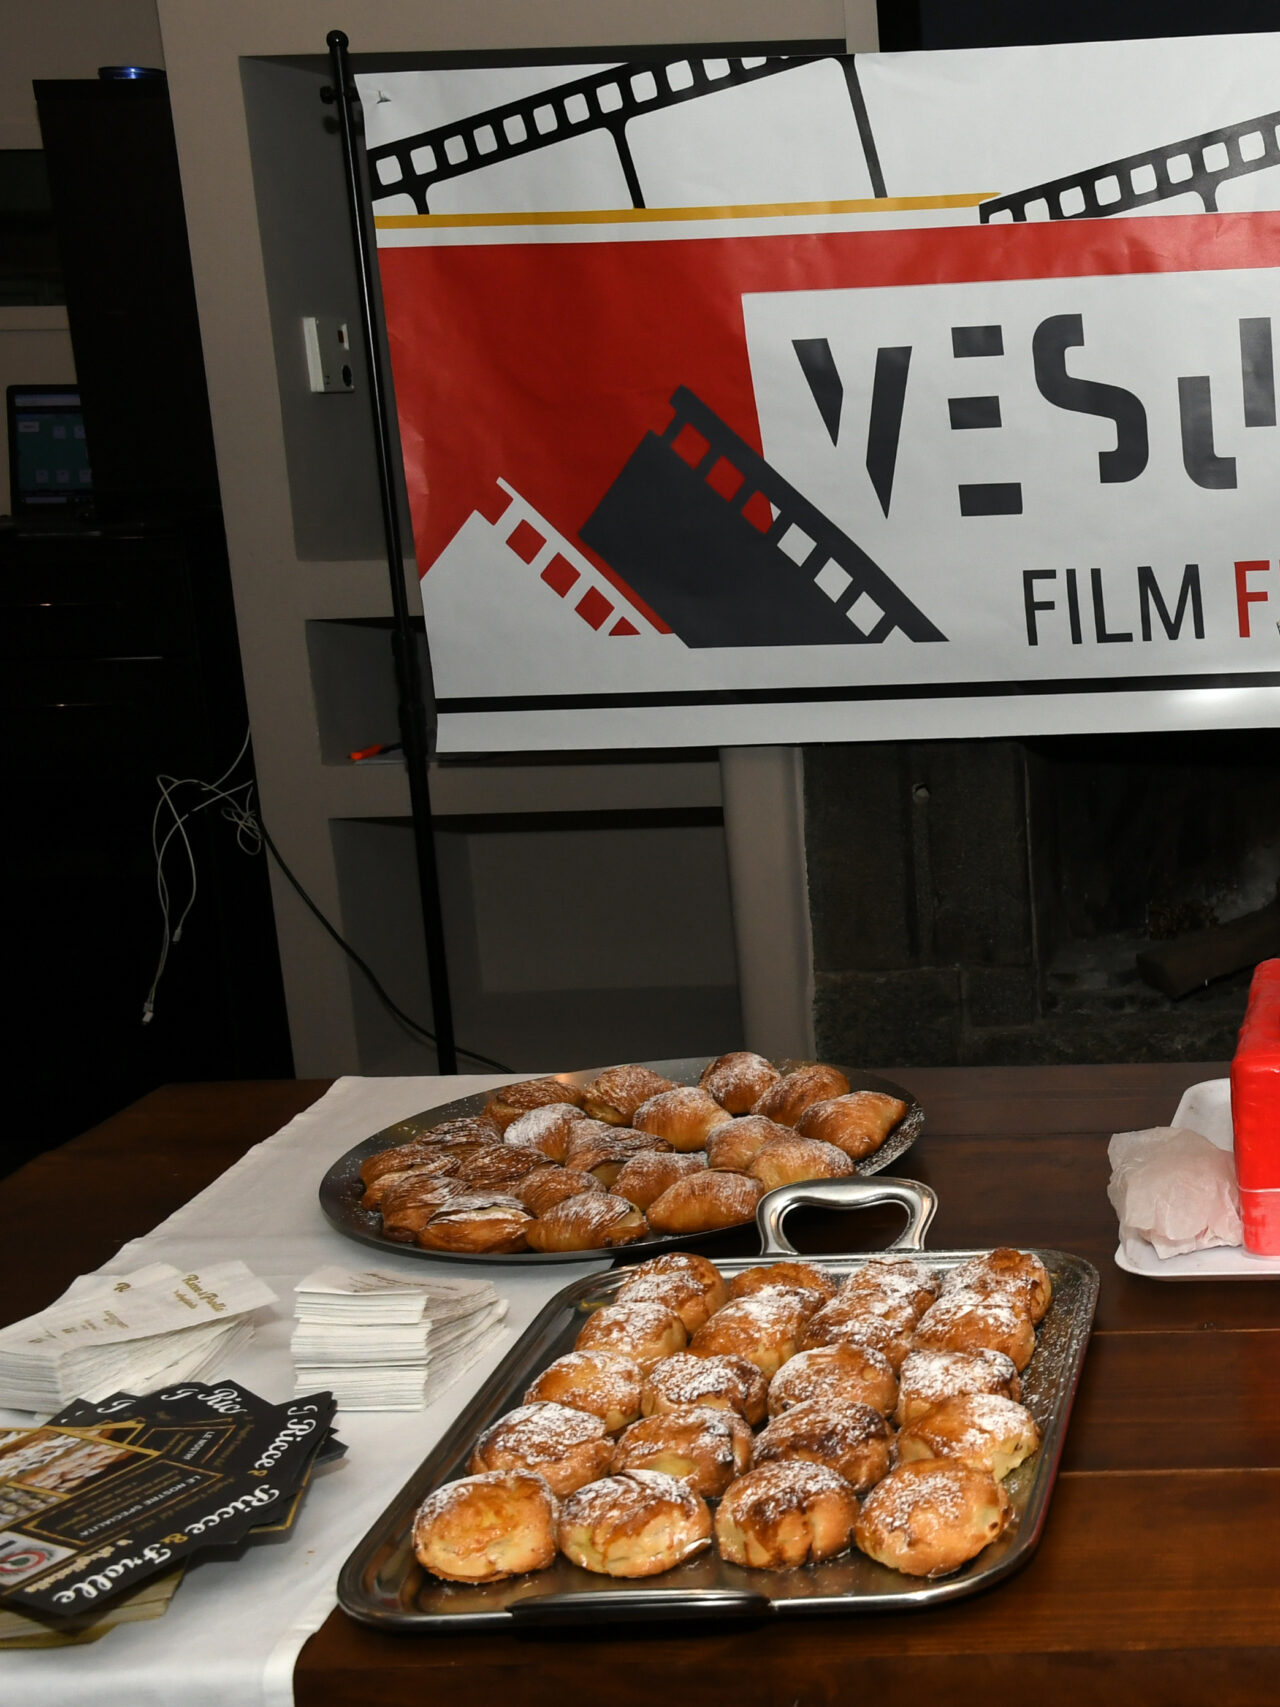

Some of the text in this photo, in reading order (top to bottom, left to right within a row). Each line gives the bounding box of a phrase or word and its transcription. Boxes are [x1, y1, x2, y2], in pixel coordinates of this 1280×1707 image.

[1022, 563, 1206, 647] FILM
[197, 1388, 248, 1414] Ric
[254, 1419, 317, 1470] Ricce
[145, 1482, 187, 1507] NOSTRE
[184, 1484, 281, 1535] Ricce
[159, 1532, 189, 1545] &
[53, 1543, 172, 1604] Frolle
